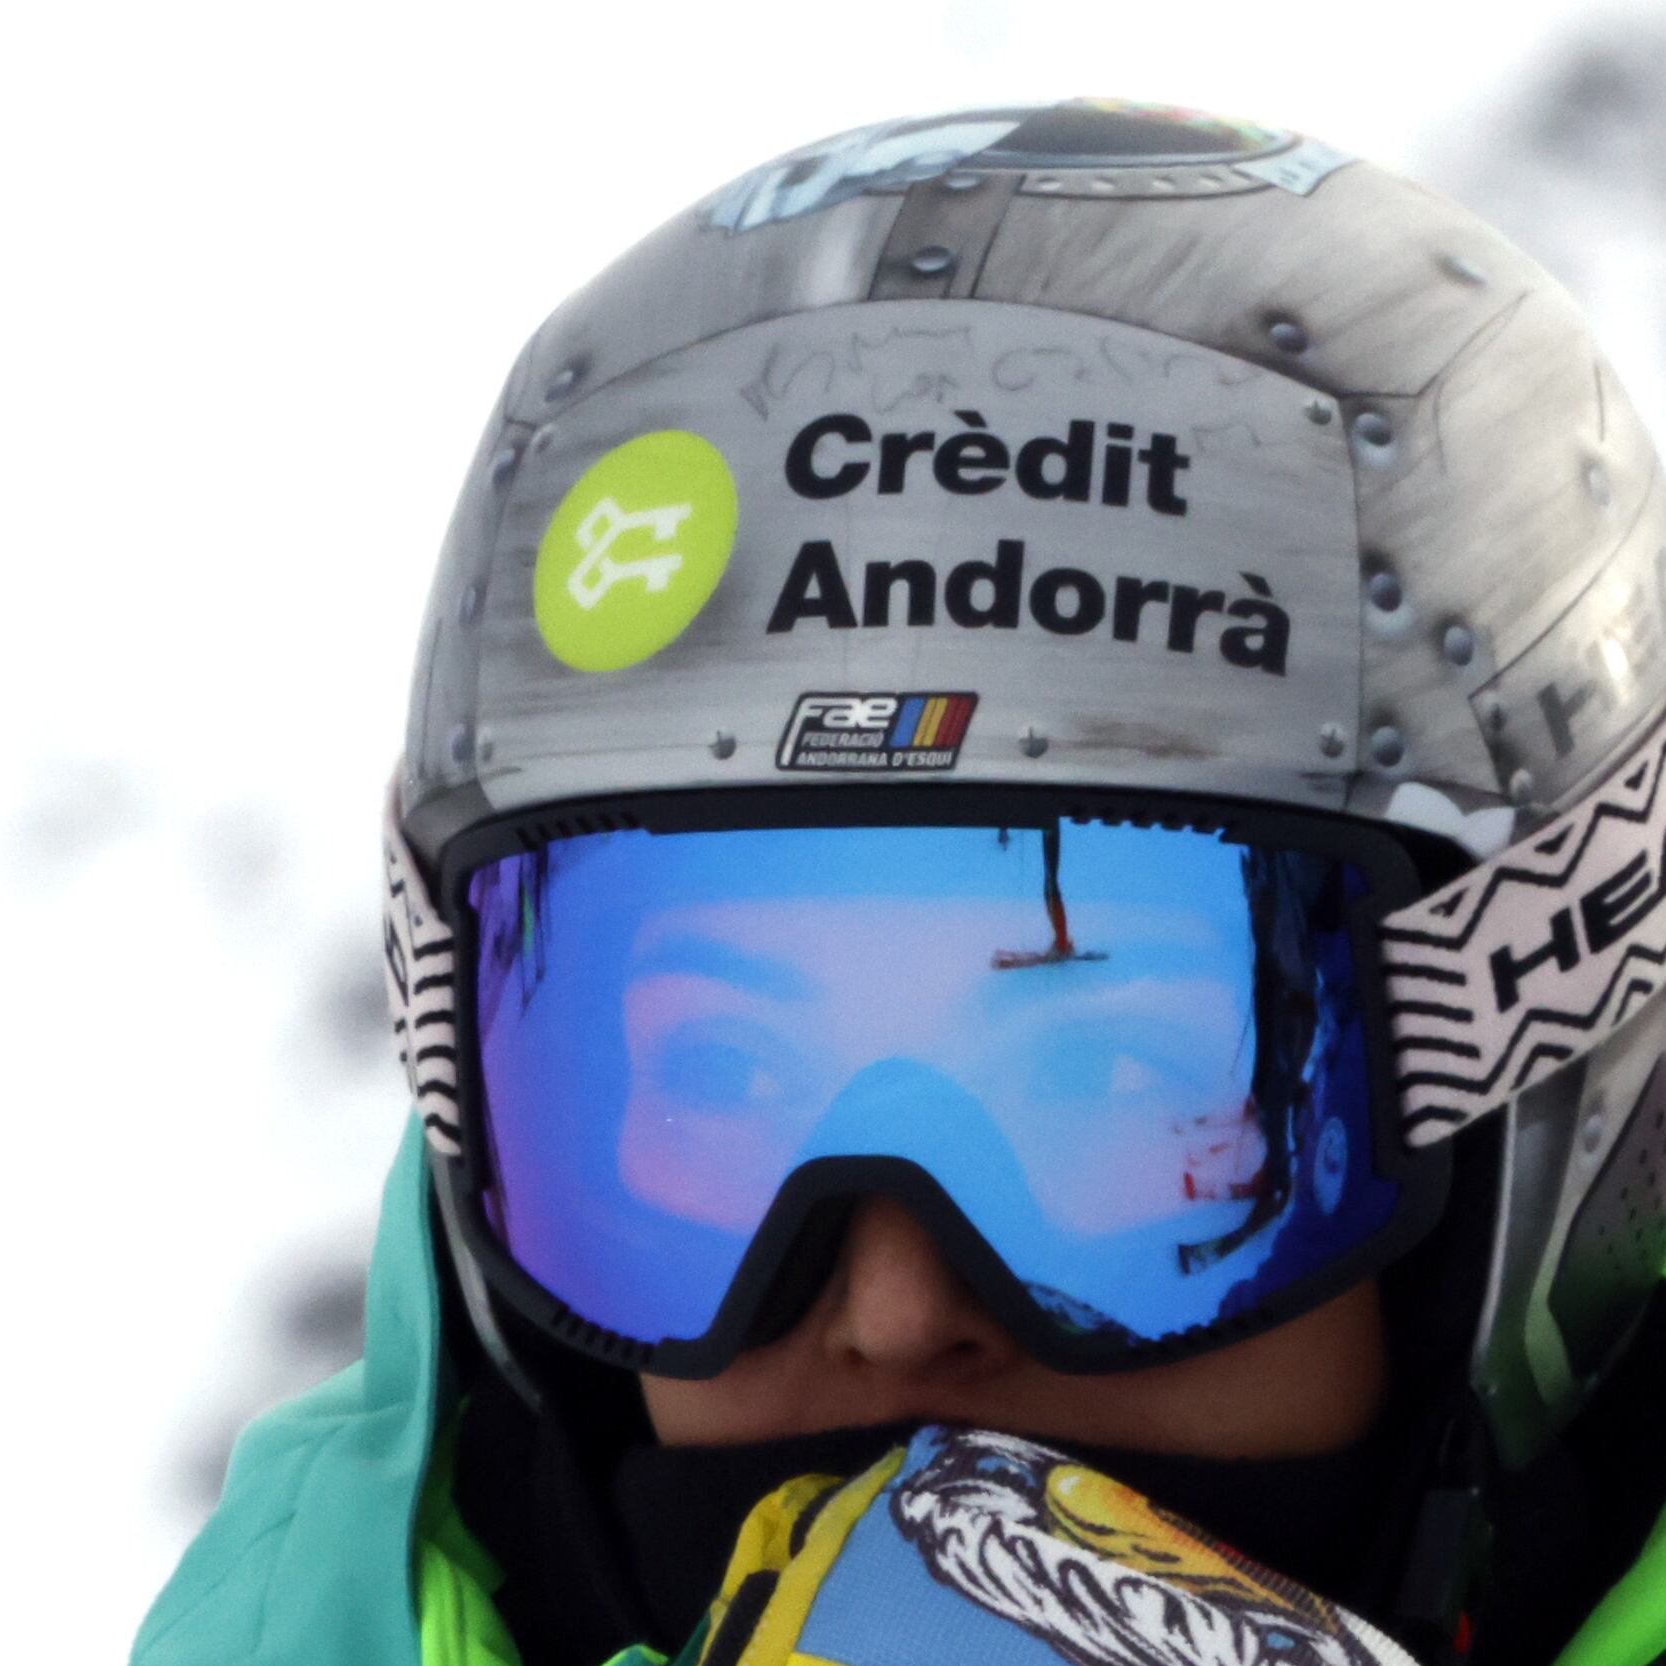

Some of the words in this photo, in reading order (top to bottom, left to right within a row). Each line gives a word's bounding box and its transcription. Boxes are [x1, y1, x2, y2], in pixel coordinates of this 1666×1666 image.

[783, 411, 1191, 518] Crèdit
[764, 538, 1293, 677] Andorrà
[795, 751, 889, 768] ANDORRANA
